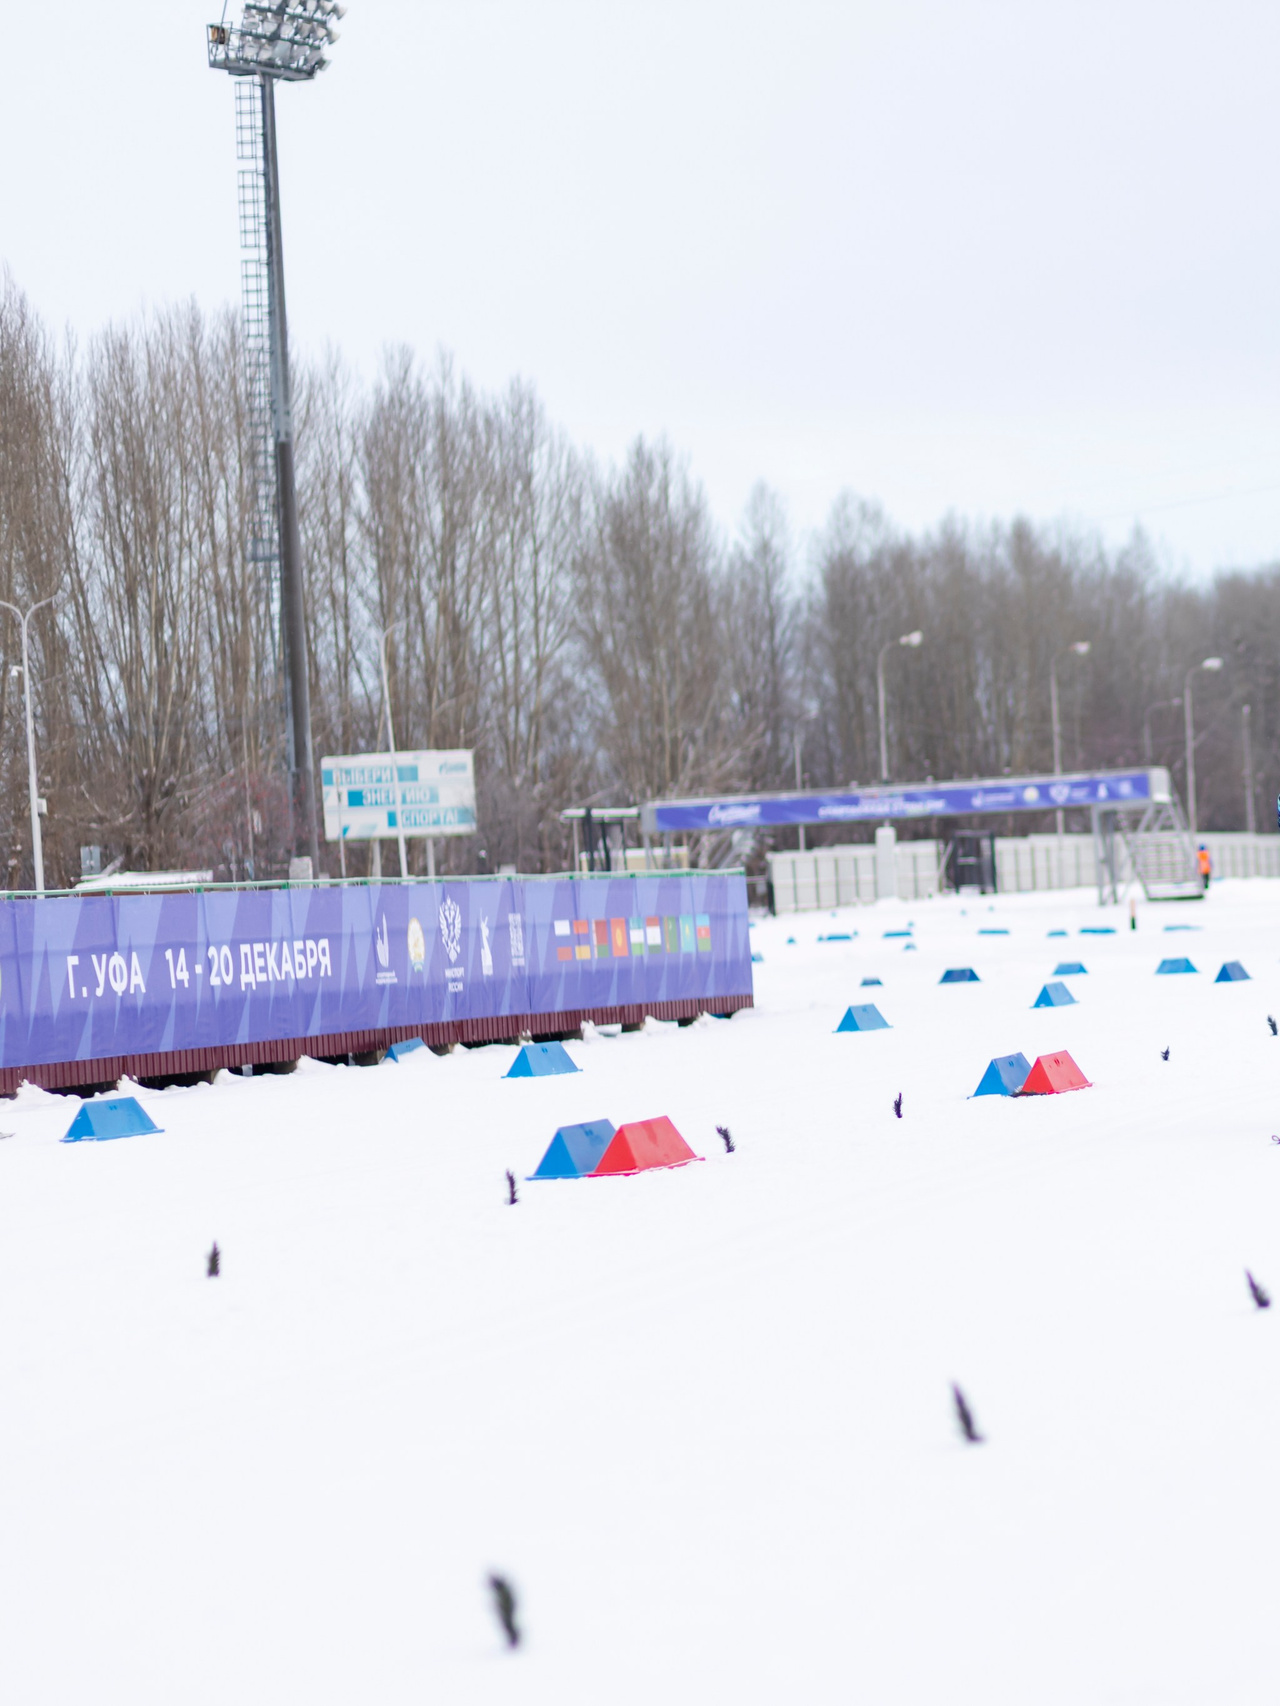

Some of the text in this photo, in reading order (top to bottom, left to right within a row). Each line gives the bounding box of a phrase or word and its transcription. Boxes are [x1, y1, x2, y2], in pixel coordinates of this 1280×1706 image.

[66, 955, 88, 999] Г.
[91, 951, 146, 997] УФА
[165, 947, 190, 989] 14
[207, 944, 234, 986] 20
[239, 938, 332, 991] ДЕКАБРЯ
